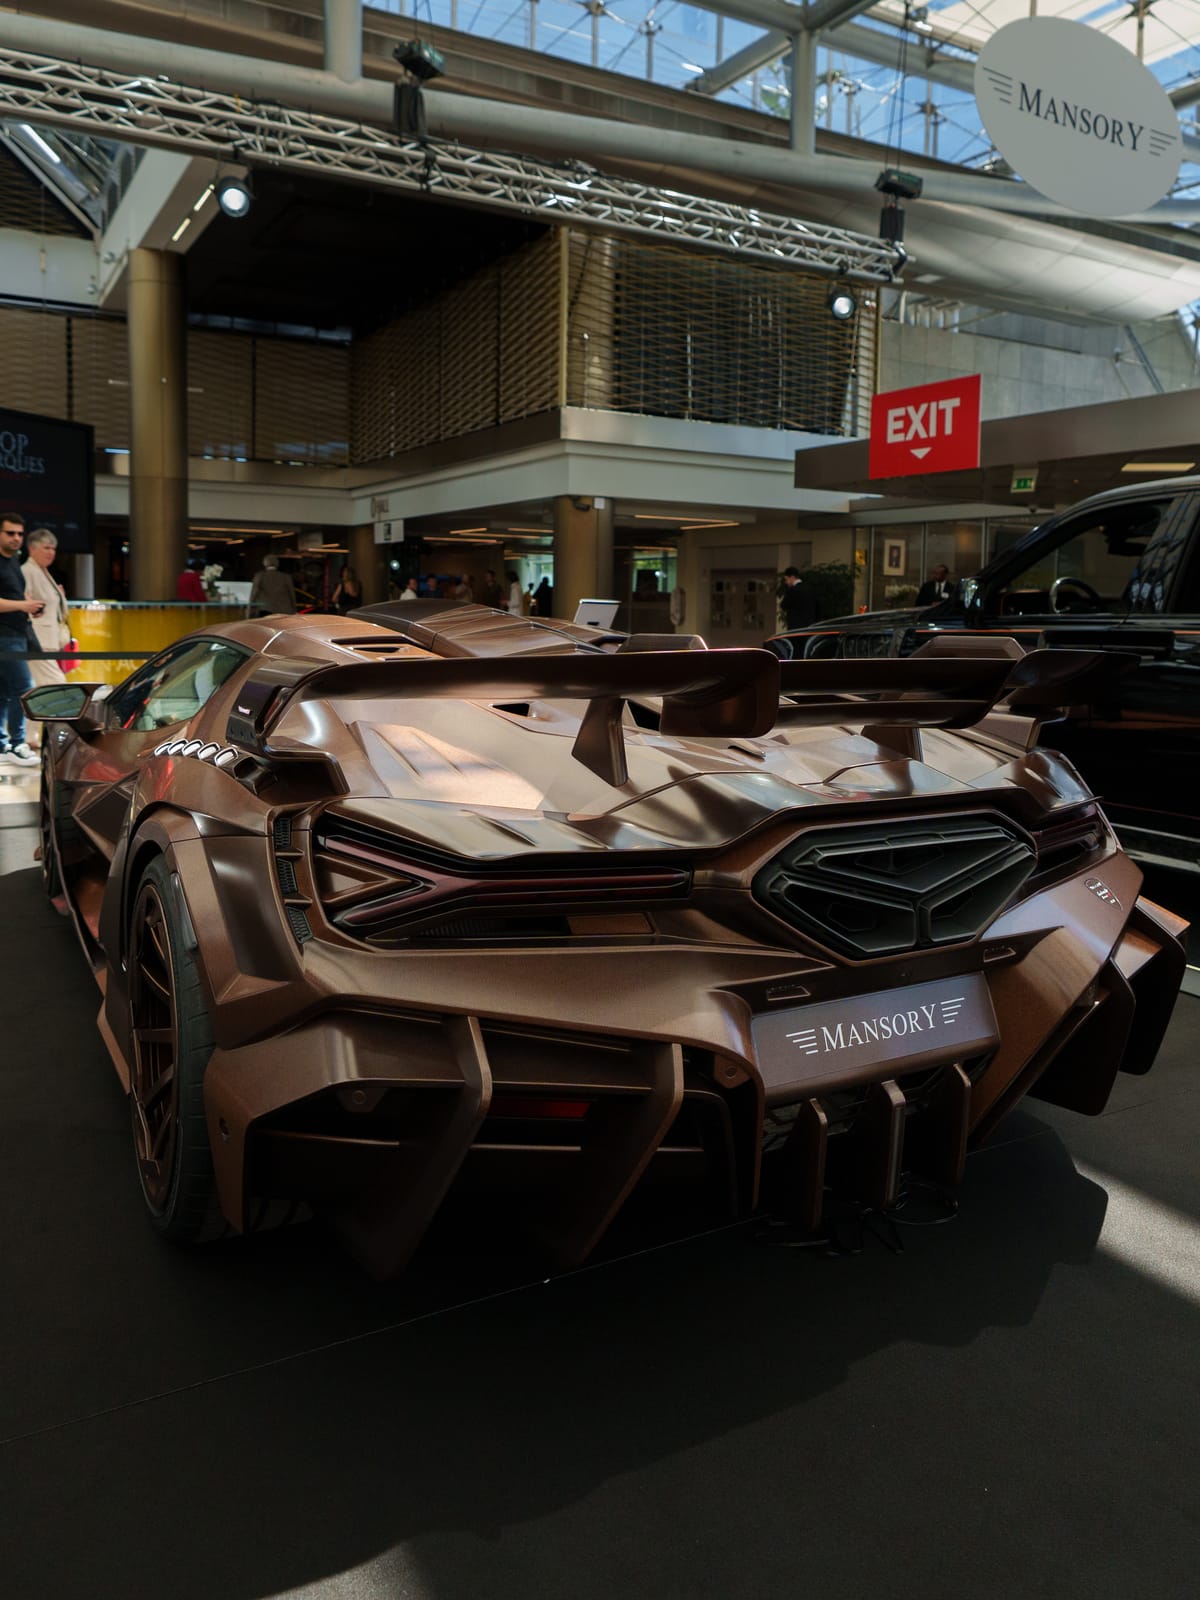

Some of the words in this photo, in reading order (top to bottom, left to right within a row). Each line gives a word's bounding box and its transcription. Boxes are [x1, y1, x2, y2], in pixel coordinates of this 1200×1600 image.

[1018, 81, 1144, 152] MANSORY
[886, 397, 961, 444] EXIT
[820, 1003, 937, 1052] MANSORY
